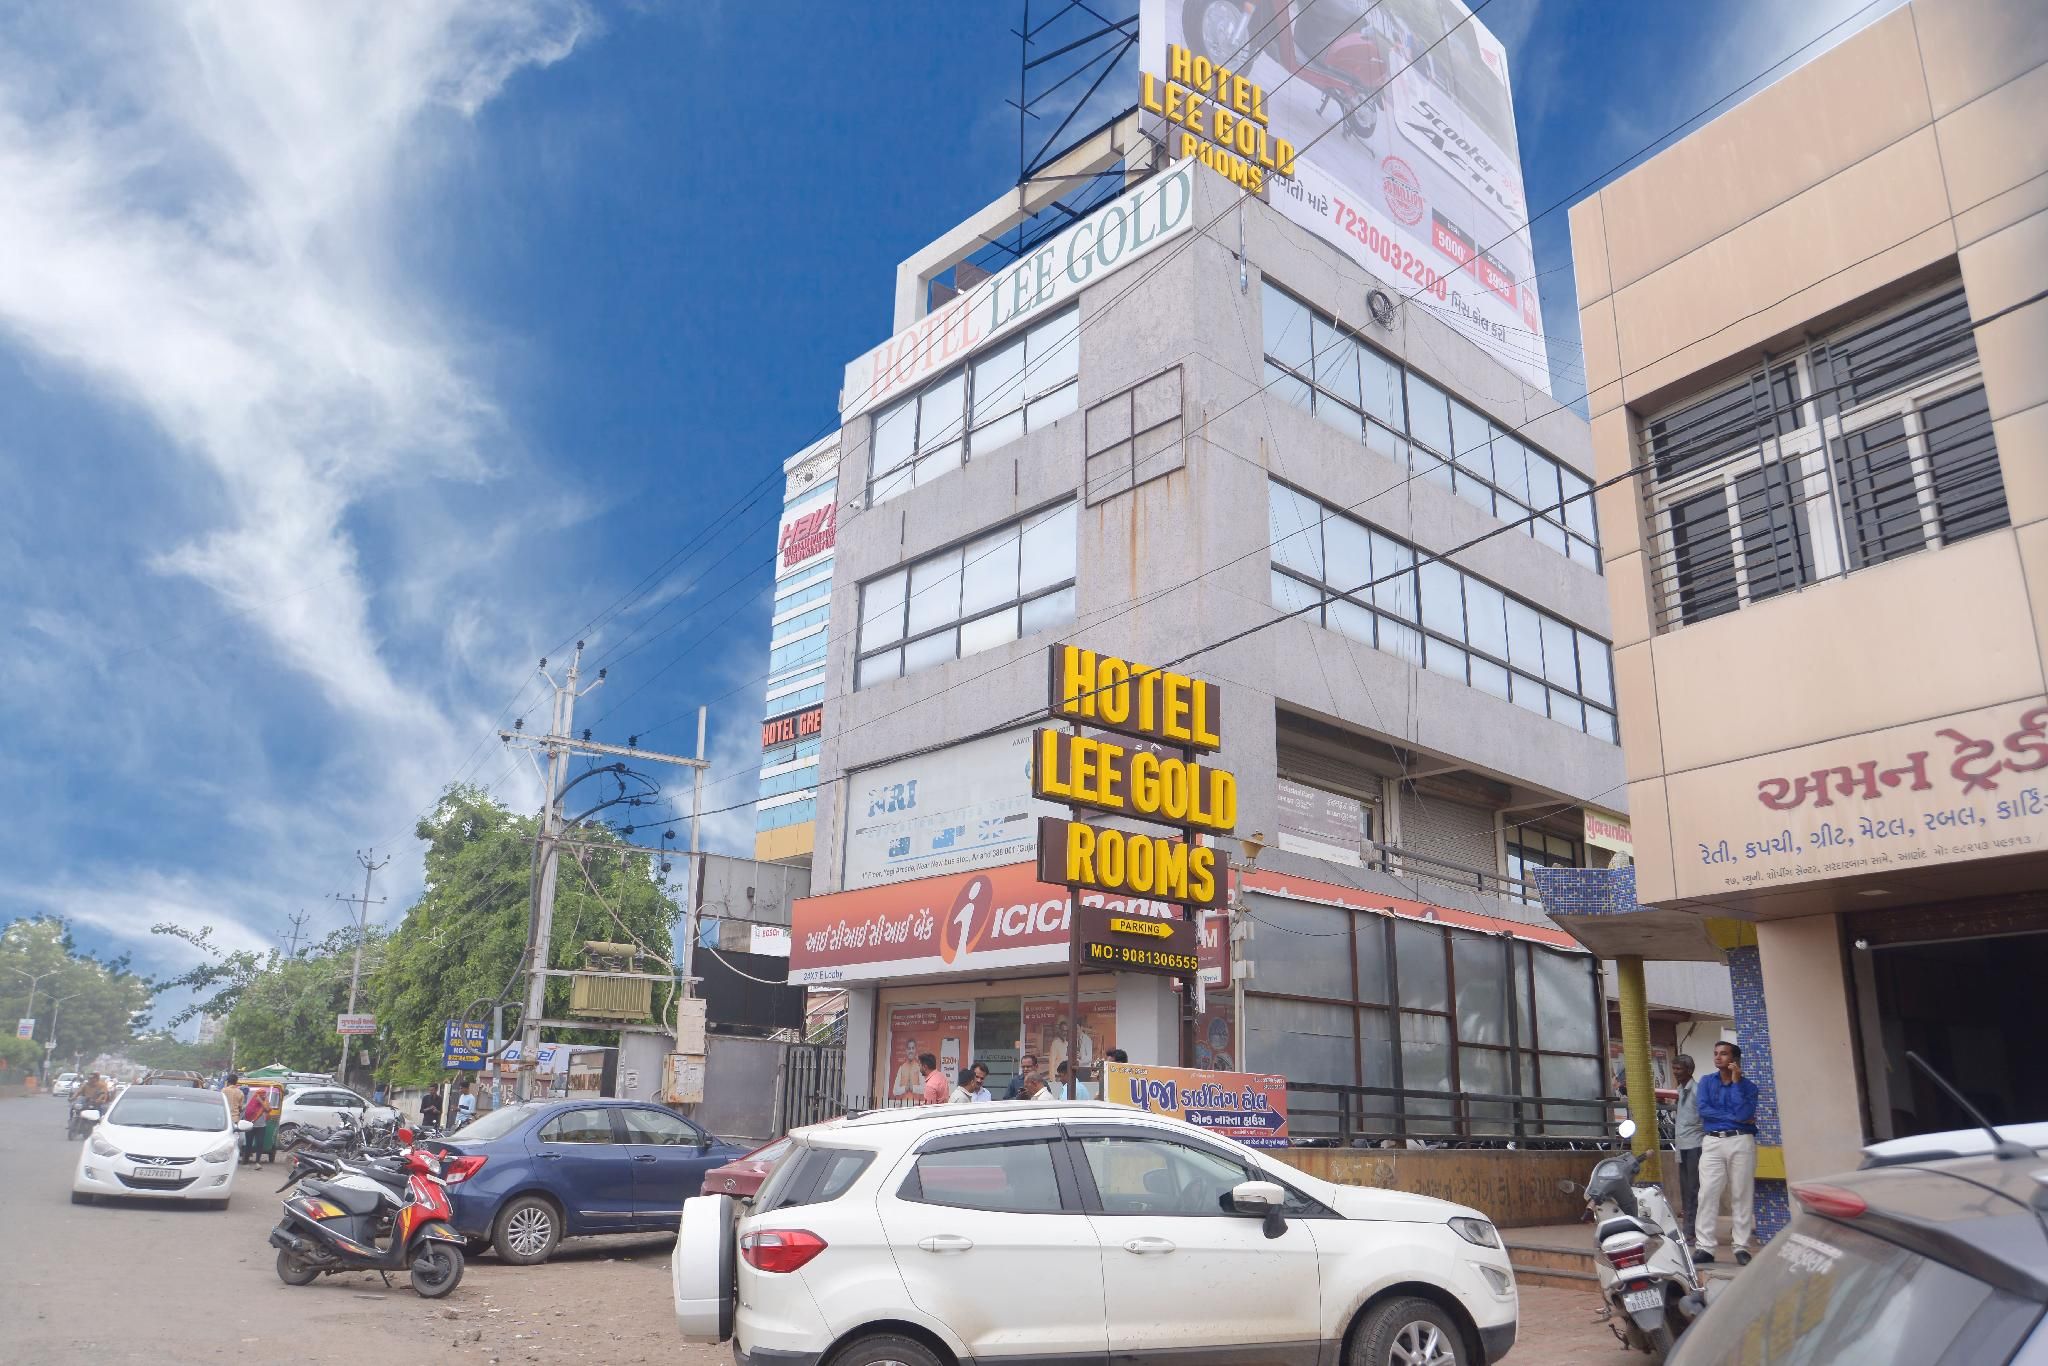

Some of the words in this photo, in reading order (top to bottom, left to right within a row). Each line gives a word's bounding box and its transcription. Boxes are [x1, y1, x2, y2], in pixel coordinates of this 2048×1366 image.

[1171, 44, 1269, 126] HOTEL
[1144, 72, 1204, 133] LEE
[1214, 109, 1295, 176] GOLD
[1411, 101, 1498, 176] Scooter
[1182, 132, 1263, 195] ROOMS
[1333, 197, 1448, 302] 7230032200
[869, 299, 980, 402] HOTEL
[988, 246, 1057, 335] LEE
[1065, 170, 1192, 285] GOLD
[763, 717, 795, 747] HOTEL
[800, 708, 823, 736] GRE
[1063, 645, 1220, 748] HOTEL
[1042, 728, 1124, 808] LEE
[1131, 751, 1238, 831] GOLD
[1758, 751, 1933, 811] અમન
[1066, 822, 1215, 902] ROOMS
[1698, 839, 1738, 865] રેતી,
[1744, 829, 1802, 860] કપચી,
[1810, 822, 1855, 849] ગ્રીટ,
[1859, 816, 1915, 840] મેટલ,
[1924, 807, 1987, 831] રબલ,
[991, 899, 1071, 938] ICICI
[1120, 921, 1160, 935] PARKING
[1122, 948, 1198, 970] 9081306555
[1241, 1085, 1269, 1112] હોલ
